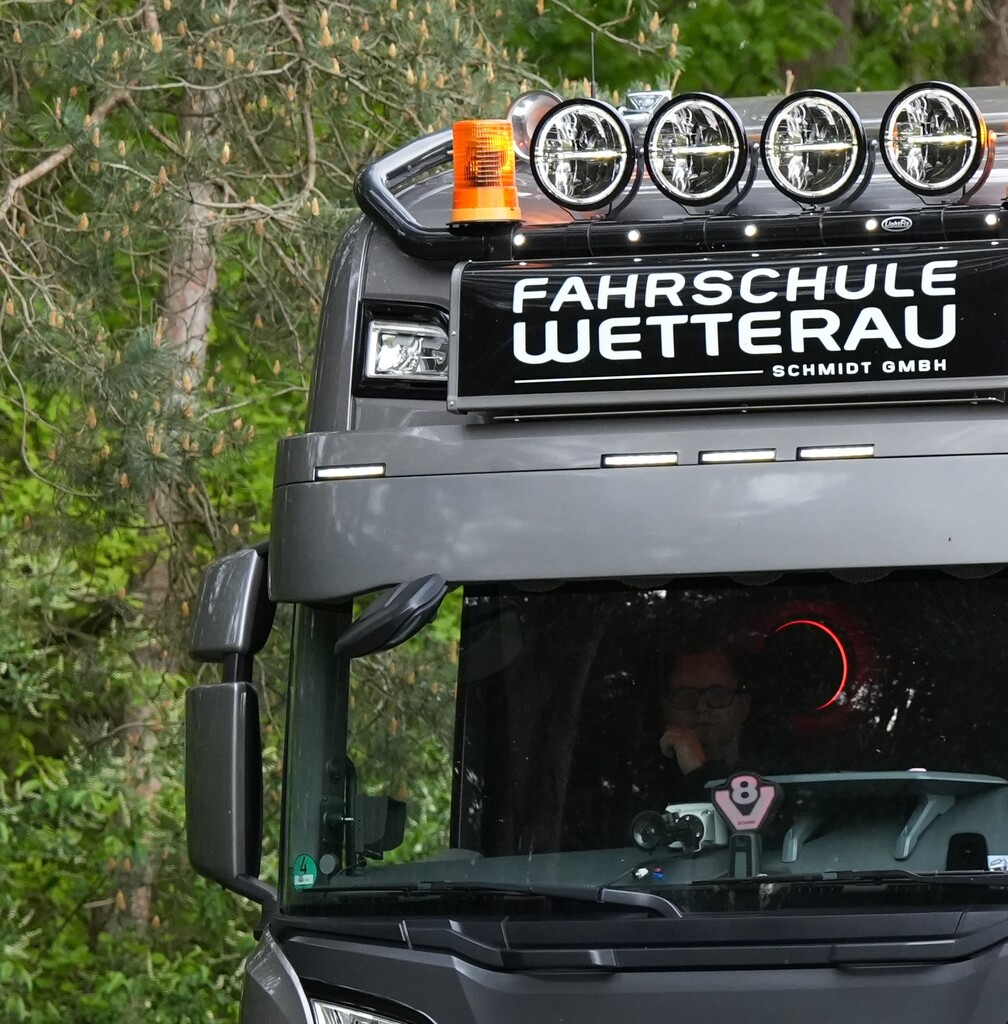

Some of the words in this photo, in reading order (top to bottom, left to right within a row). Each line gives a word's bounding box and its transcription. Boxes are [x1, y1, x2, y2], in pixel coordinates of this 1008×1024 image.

[513, 260, 959, 314] FAHRSCHULE
[513, 303, 957, 364] WETTERAU
[772, 361, 872, 378] SCHMIDT
[882, 358, 948, 374] GMBH
